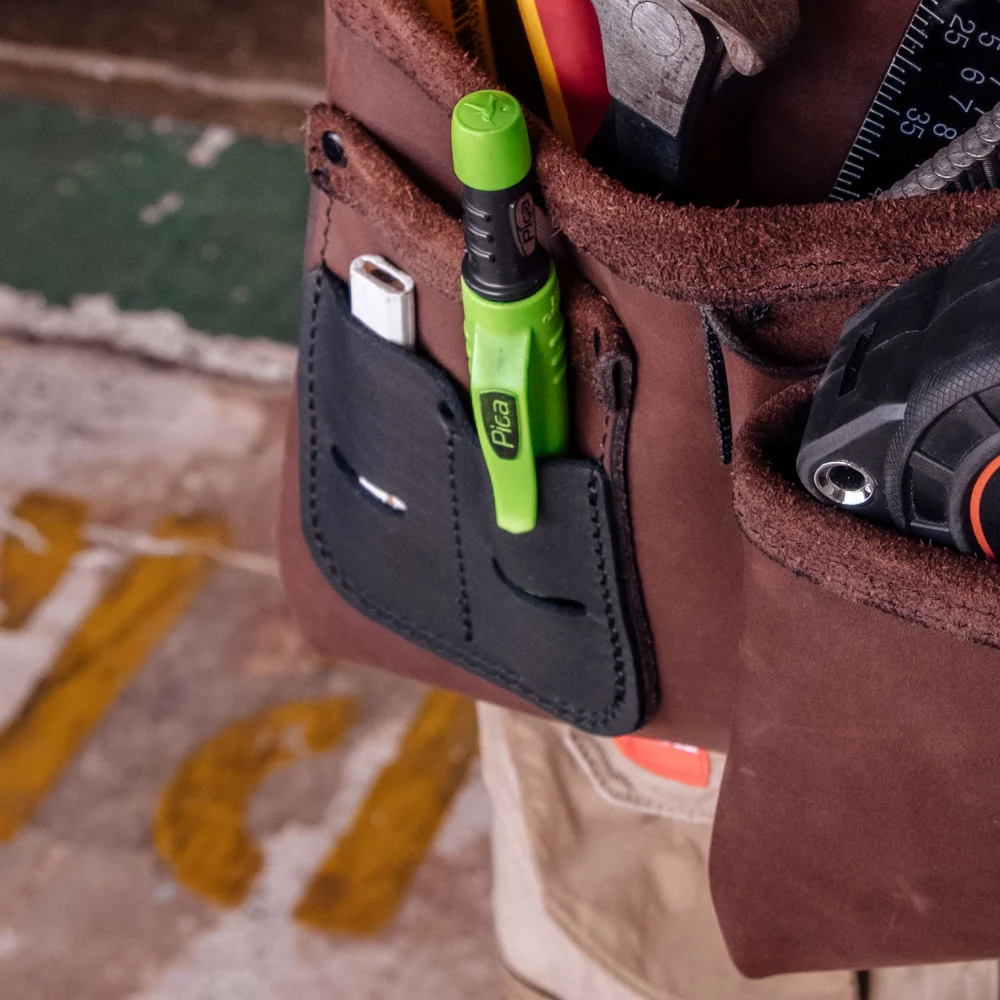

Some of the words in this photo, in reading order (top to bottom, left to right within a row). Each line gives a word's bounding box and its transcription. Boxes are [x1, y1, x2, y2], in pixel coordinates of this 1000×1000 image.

[943, 13, 976, 49] 25
[960, 66, 985, 85] 6
[949, 94, 974, 114] 7
[900, 107, 931, 139] 35
[933, 123, 957, 140] 8
[520, 198, 535, 245] Pica
[491, 399, 515, 449] Pica
